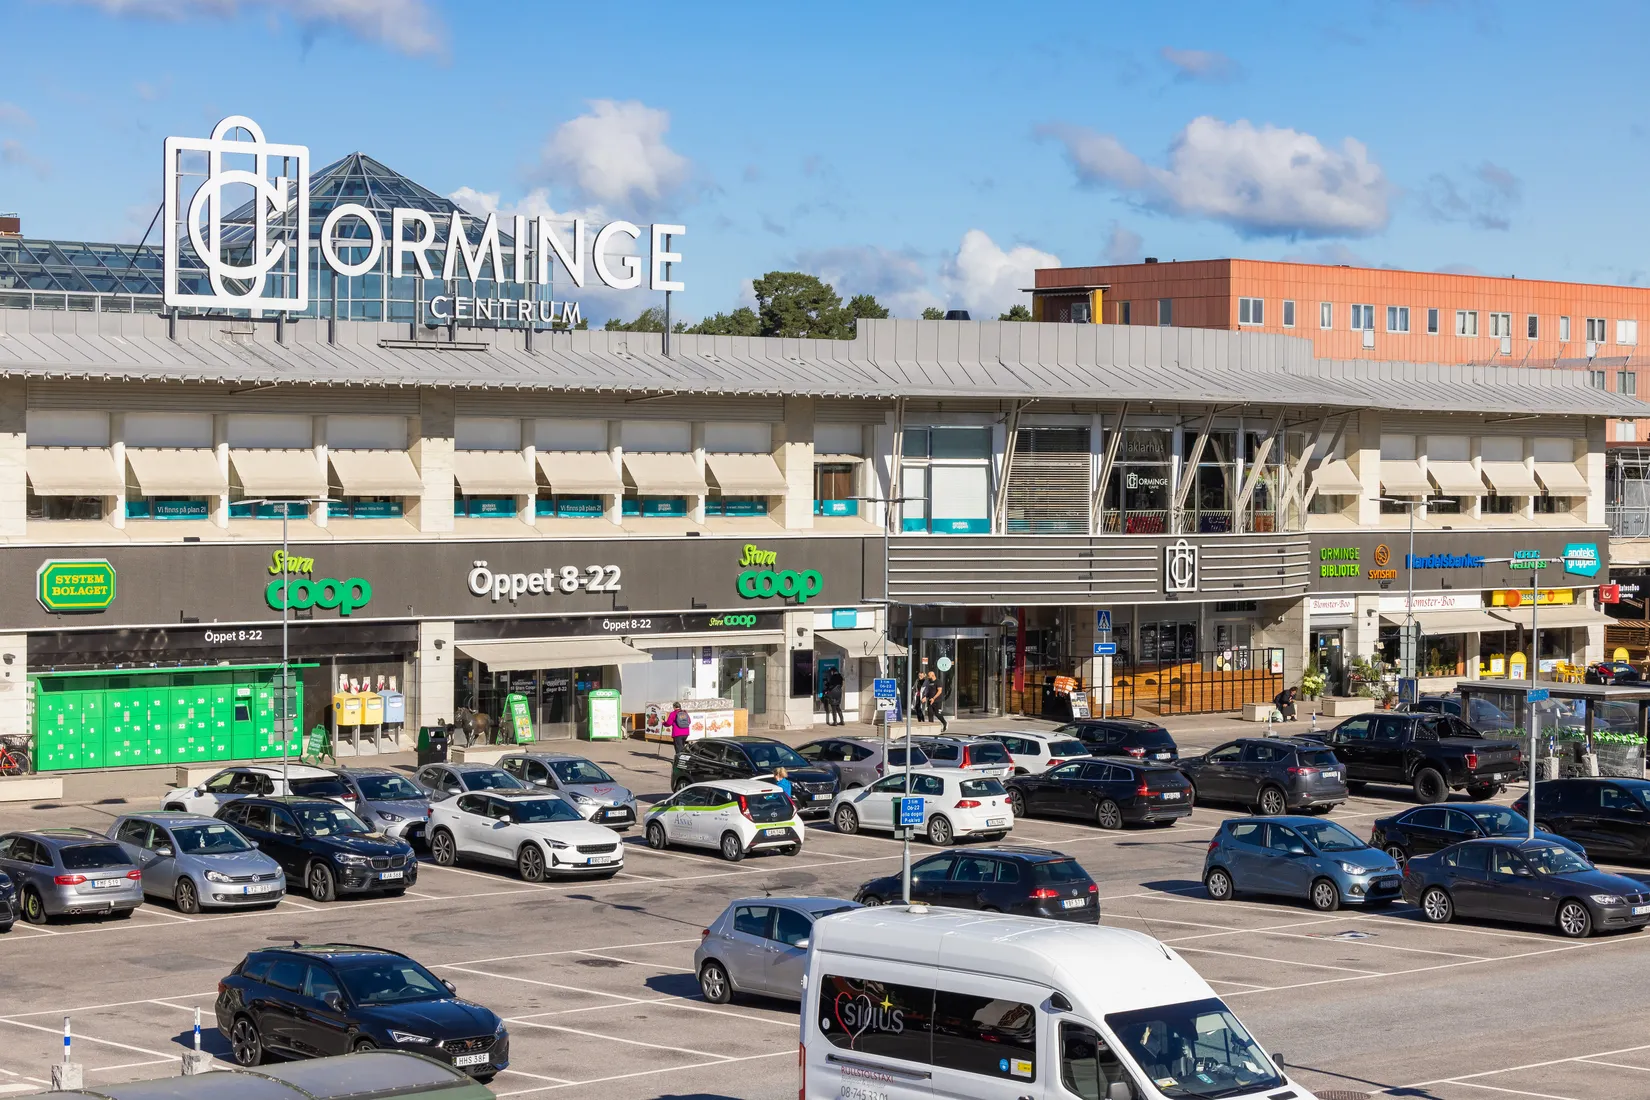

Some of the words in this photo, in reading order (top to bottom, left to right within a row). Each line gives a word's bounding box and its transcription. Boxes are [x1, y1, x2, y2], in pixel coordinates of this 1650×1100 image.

[320, 203, 686, 292] ORMINGE
[430, 295, 582, 325] CENTRUM
[738, 544, 777, 566] Stora
[1320, 548, 1360, 560] ORMINGE
[1405, 552, 1485, 569] Handelsbanken
[268, 550, 314, 575] Stora
[1320, 564, 1360, 578] BIBLIOTEK
[1368, 569, 1397, 580] SYNSAM
[55, 574, 104, 585] SYSTEM
[468, 560, 554, 602] Öppet
[560, 565, 621, 592] 8-22
[736, 569, 824, 604] coop
[52, 586, 108, 596] BOLAGET
[266, 577, 372, 615] coop
[1313, 600, 1350, 609] Blomster-Boo
[602, 619, 629, 631] Öppet
[631, 620, 651, 628] 8-22
[724, 615, 756, 627] coop
[204, 629, 236, 642] Öppet
[238, 630, 262, 641] 8-22
[458, 1056, 473, 1065] HHS
[474, 1054, 486, 1064] 38F
[841, 1066, 894, 1083] RULLSTOLSTAXI
[841, 1086, 866, 1100] 08-745
